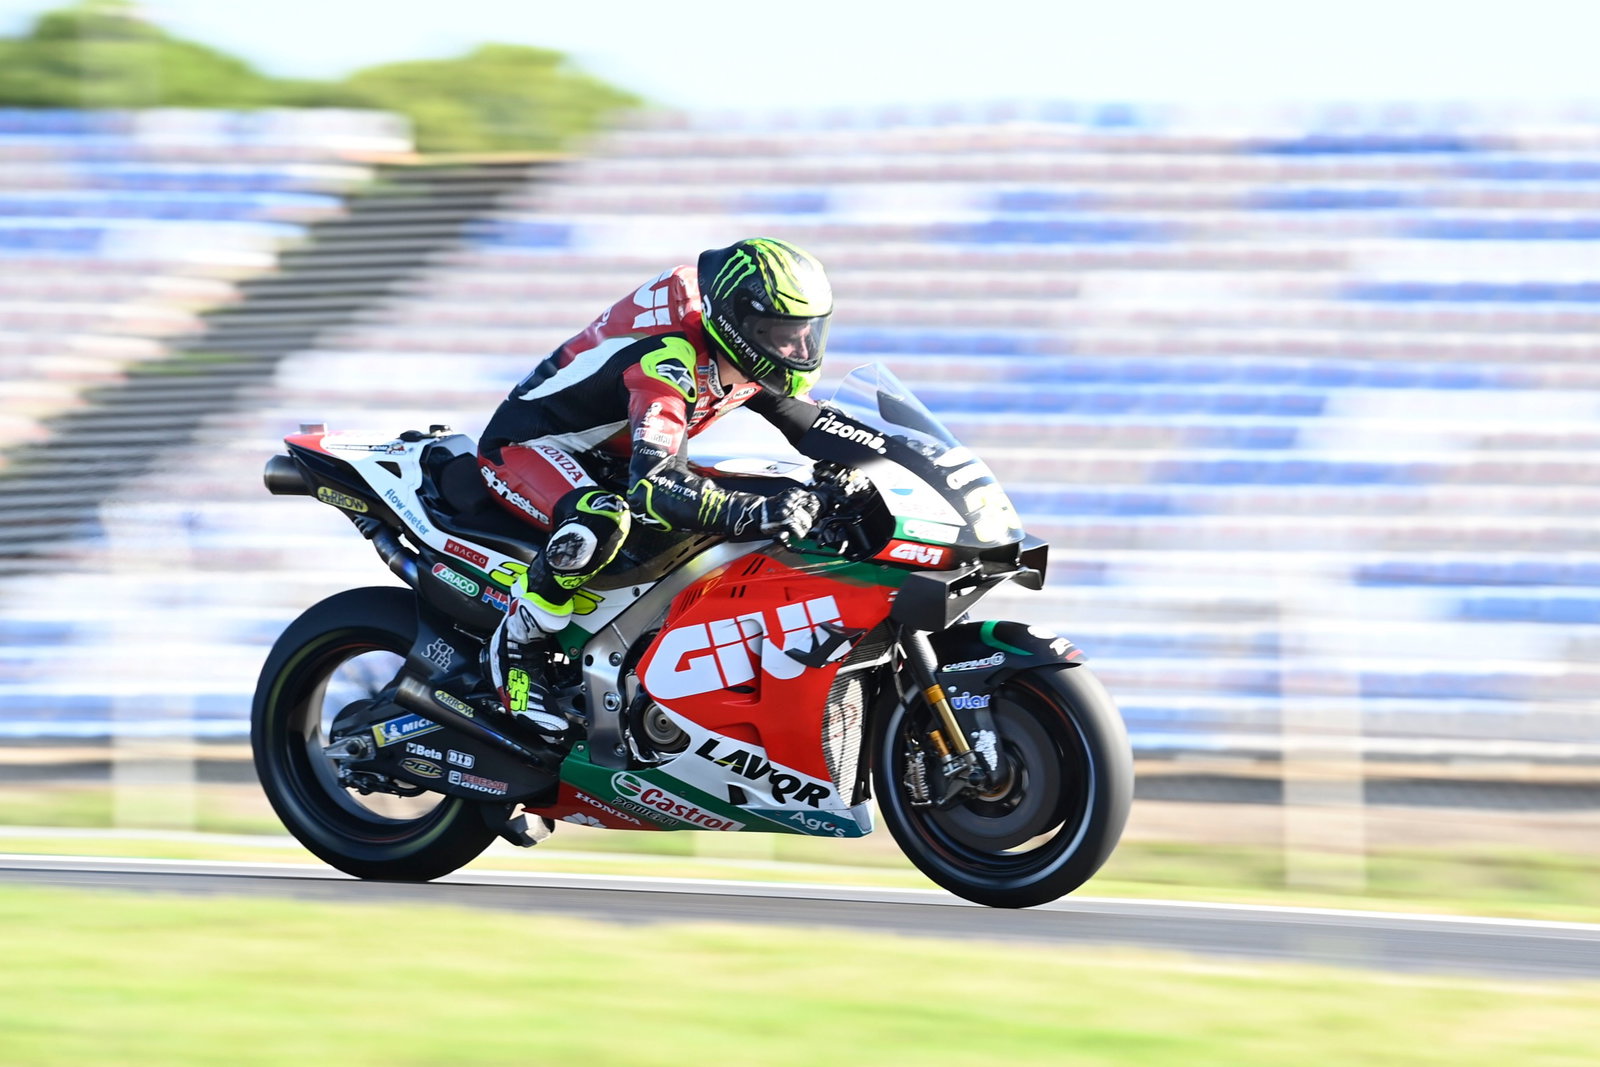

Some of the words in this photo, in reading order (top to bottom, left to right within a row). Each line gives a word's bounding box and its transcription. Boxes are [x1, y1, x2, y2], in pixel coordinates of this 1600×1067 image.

[319, 489, 367, 511] ARROW
[480, 465, 550, 525] alpinestars
[384, 488, 406, 512] flow
[403, 510, 430, 535] meter
[889, 543, 944, 566] GIVI
[439, 569, 476, 595] DRACO
[644, 595, 844, 700] GIVI
[507, 667, 530, 712] 35
[437, 692, 475, 716] ARROW
[416, 744, 442, 760] Beta
[461, 781, 506, 796] GROUP
[574, 791, 642, 826] HONDA
[640, 788, 735, 831] Castrol
[789, 811, 846, 837] Agos
